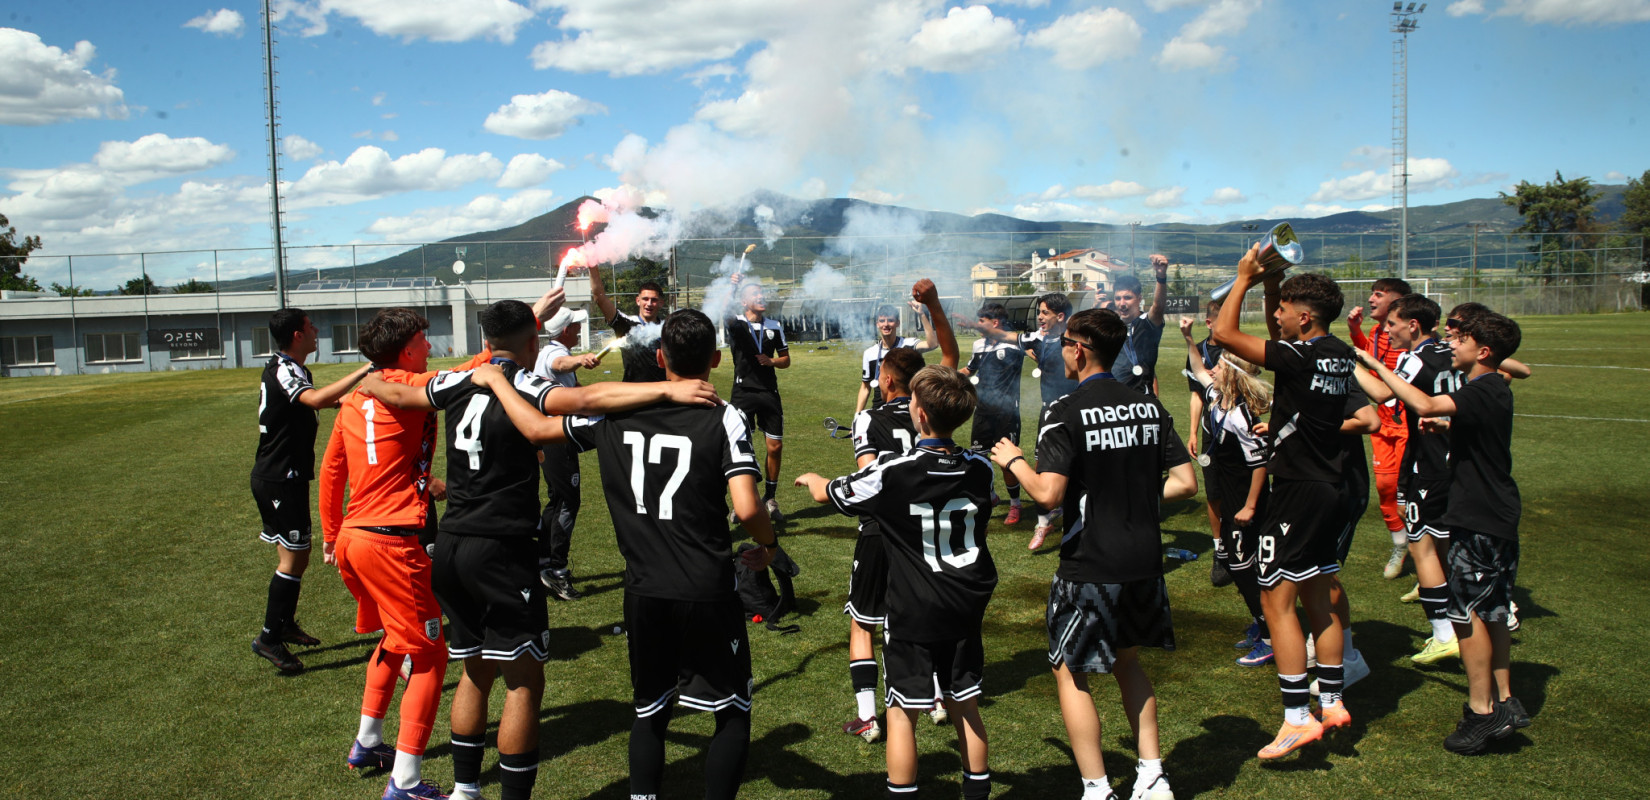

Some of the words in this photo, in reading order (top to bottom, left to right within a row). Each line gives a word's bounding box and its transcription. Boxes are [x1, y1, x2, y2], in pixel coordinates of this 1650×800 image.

[1166, 299, 1192, 308] OPEN
[164, 332, 203, 342] OPEN
[1080, 403, 1160, 426] macron
[361, 398, 378, 464] 1
[454, 393, 490, 470] 4
[1085, 425, 1139, 451] PAOK
[623, 431, 692, 520] 17
[909, 498, 979, 572] 10
[1232, 531, 1242, 552] 7
[1258, 535, 1275, 563] 19
